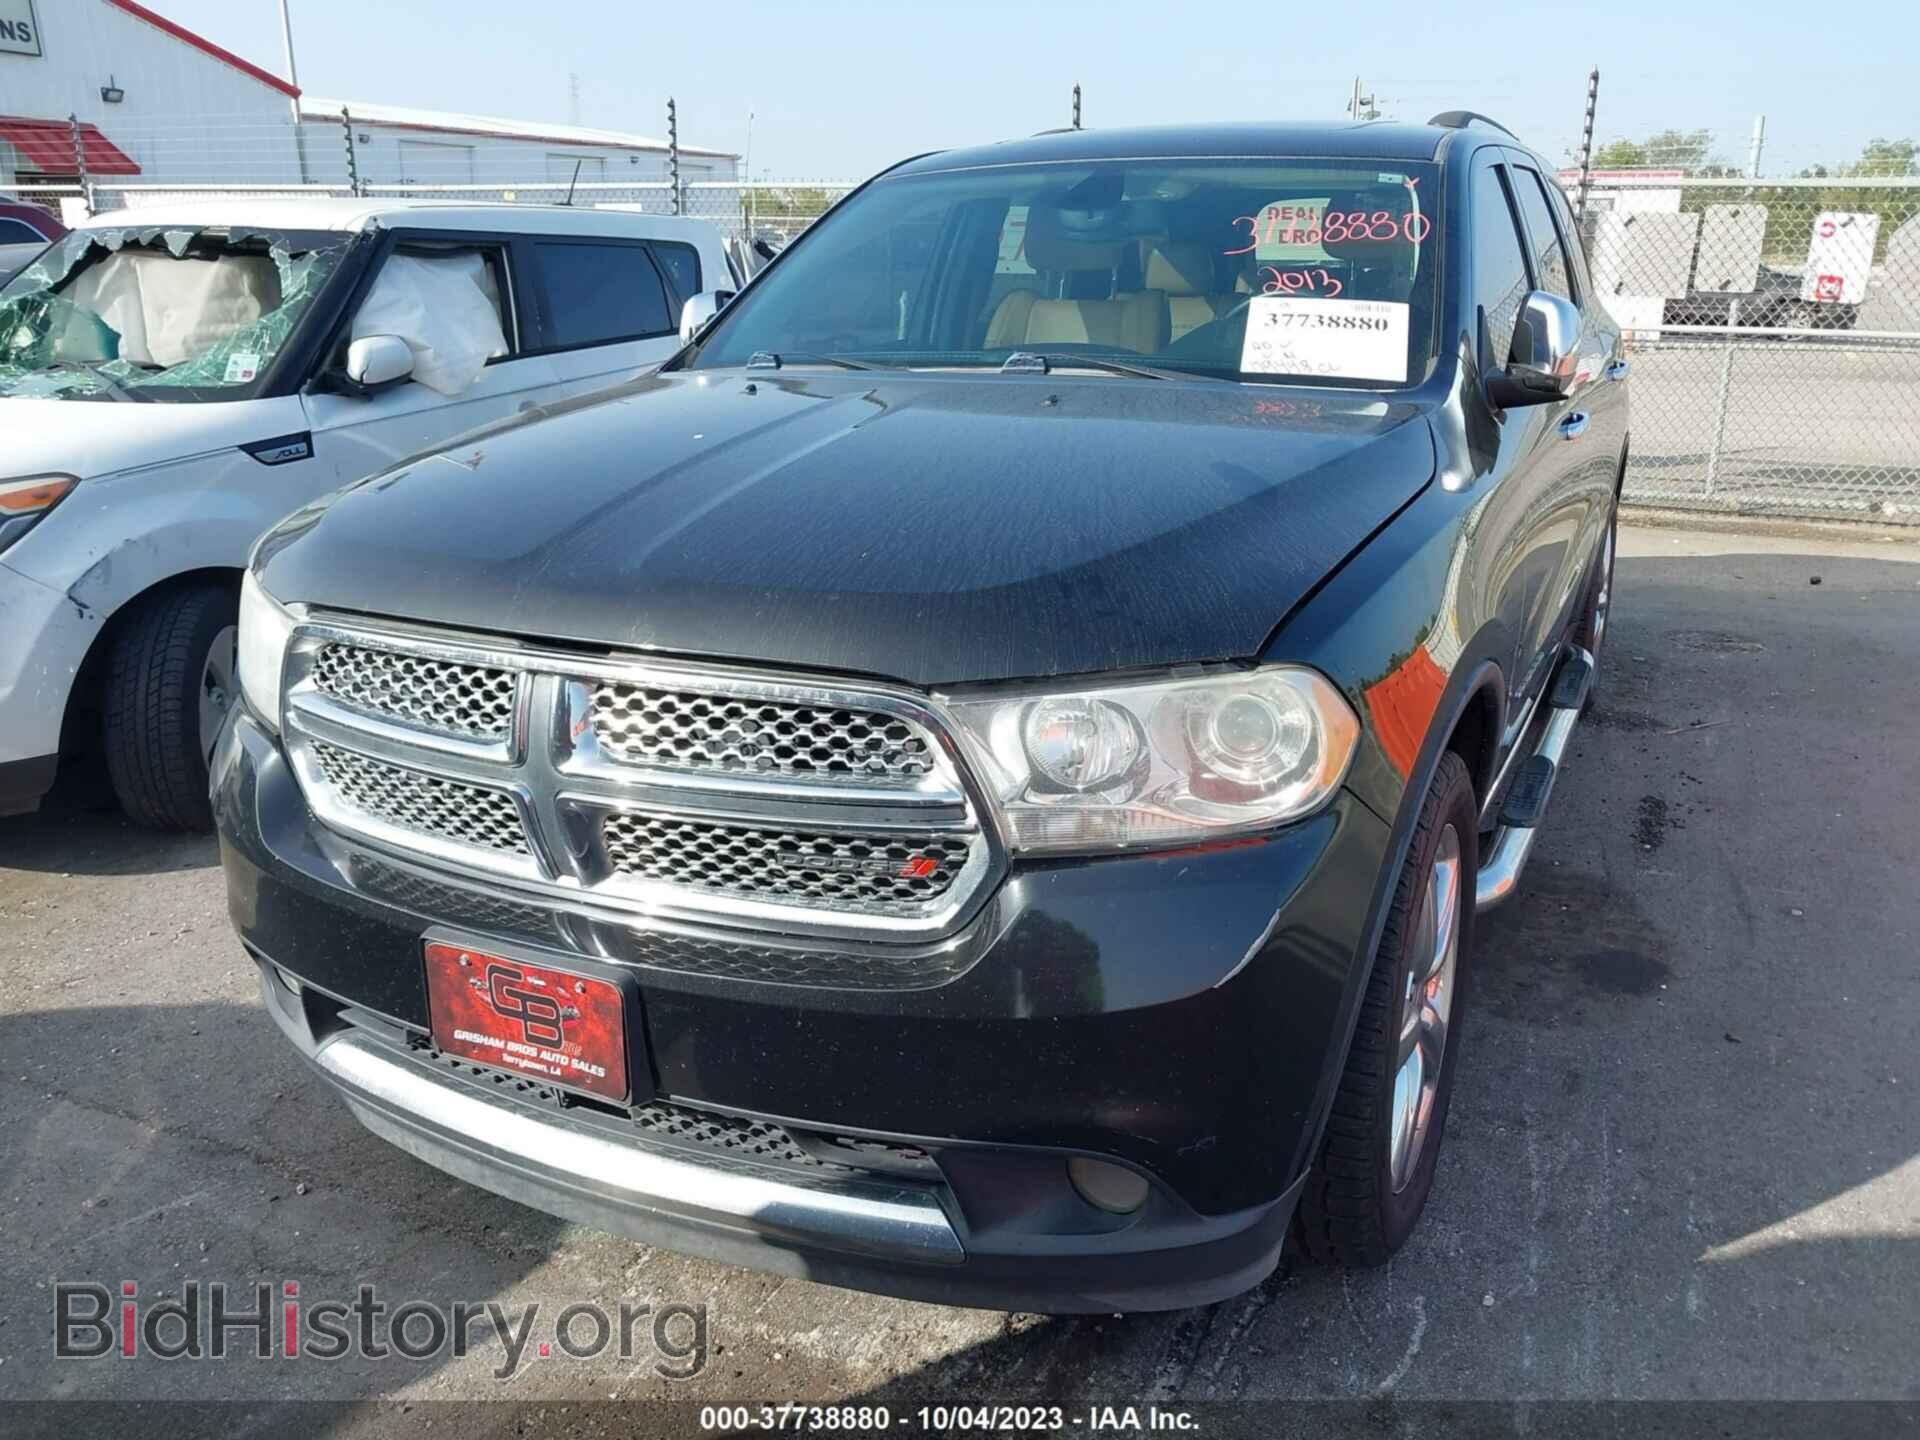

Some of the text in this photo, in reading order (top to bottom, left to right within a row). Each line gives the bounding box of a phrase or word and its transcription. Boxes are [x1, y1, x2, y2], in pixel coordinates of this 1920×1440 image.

[1258, 266, 1343, 297] 2013
[1264, 312, 1389, 331] 37738880
[454, 1029, 606, 1077] GRISHAM BROS AUTO SALES
